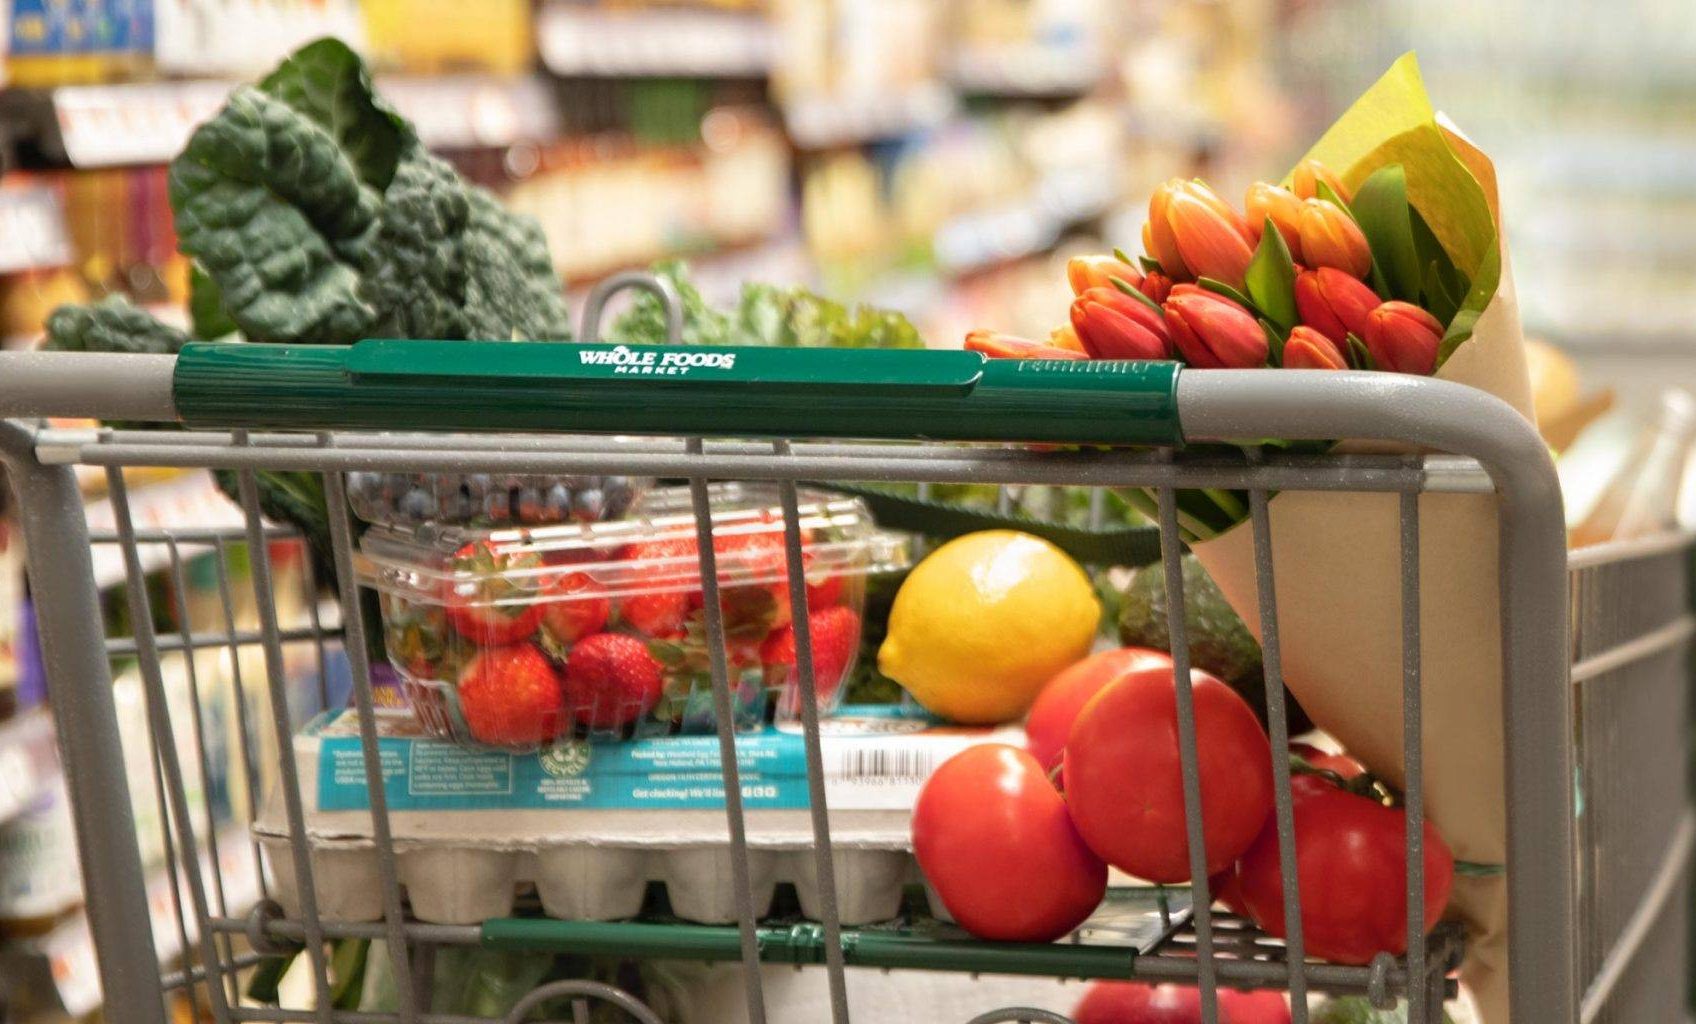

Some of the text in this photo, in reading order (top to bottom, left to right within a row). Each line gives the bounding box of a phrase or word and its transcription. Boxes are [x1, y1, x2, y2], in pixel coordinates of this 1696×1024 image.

[579, 345, 736, 369] WHOLE FOODS
[614, 366, 690, 375] MARKET
